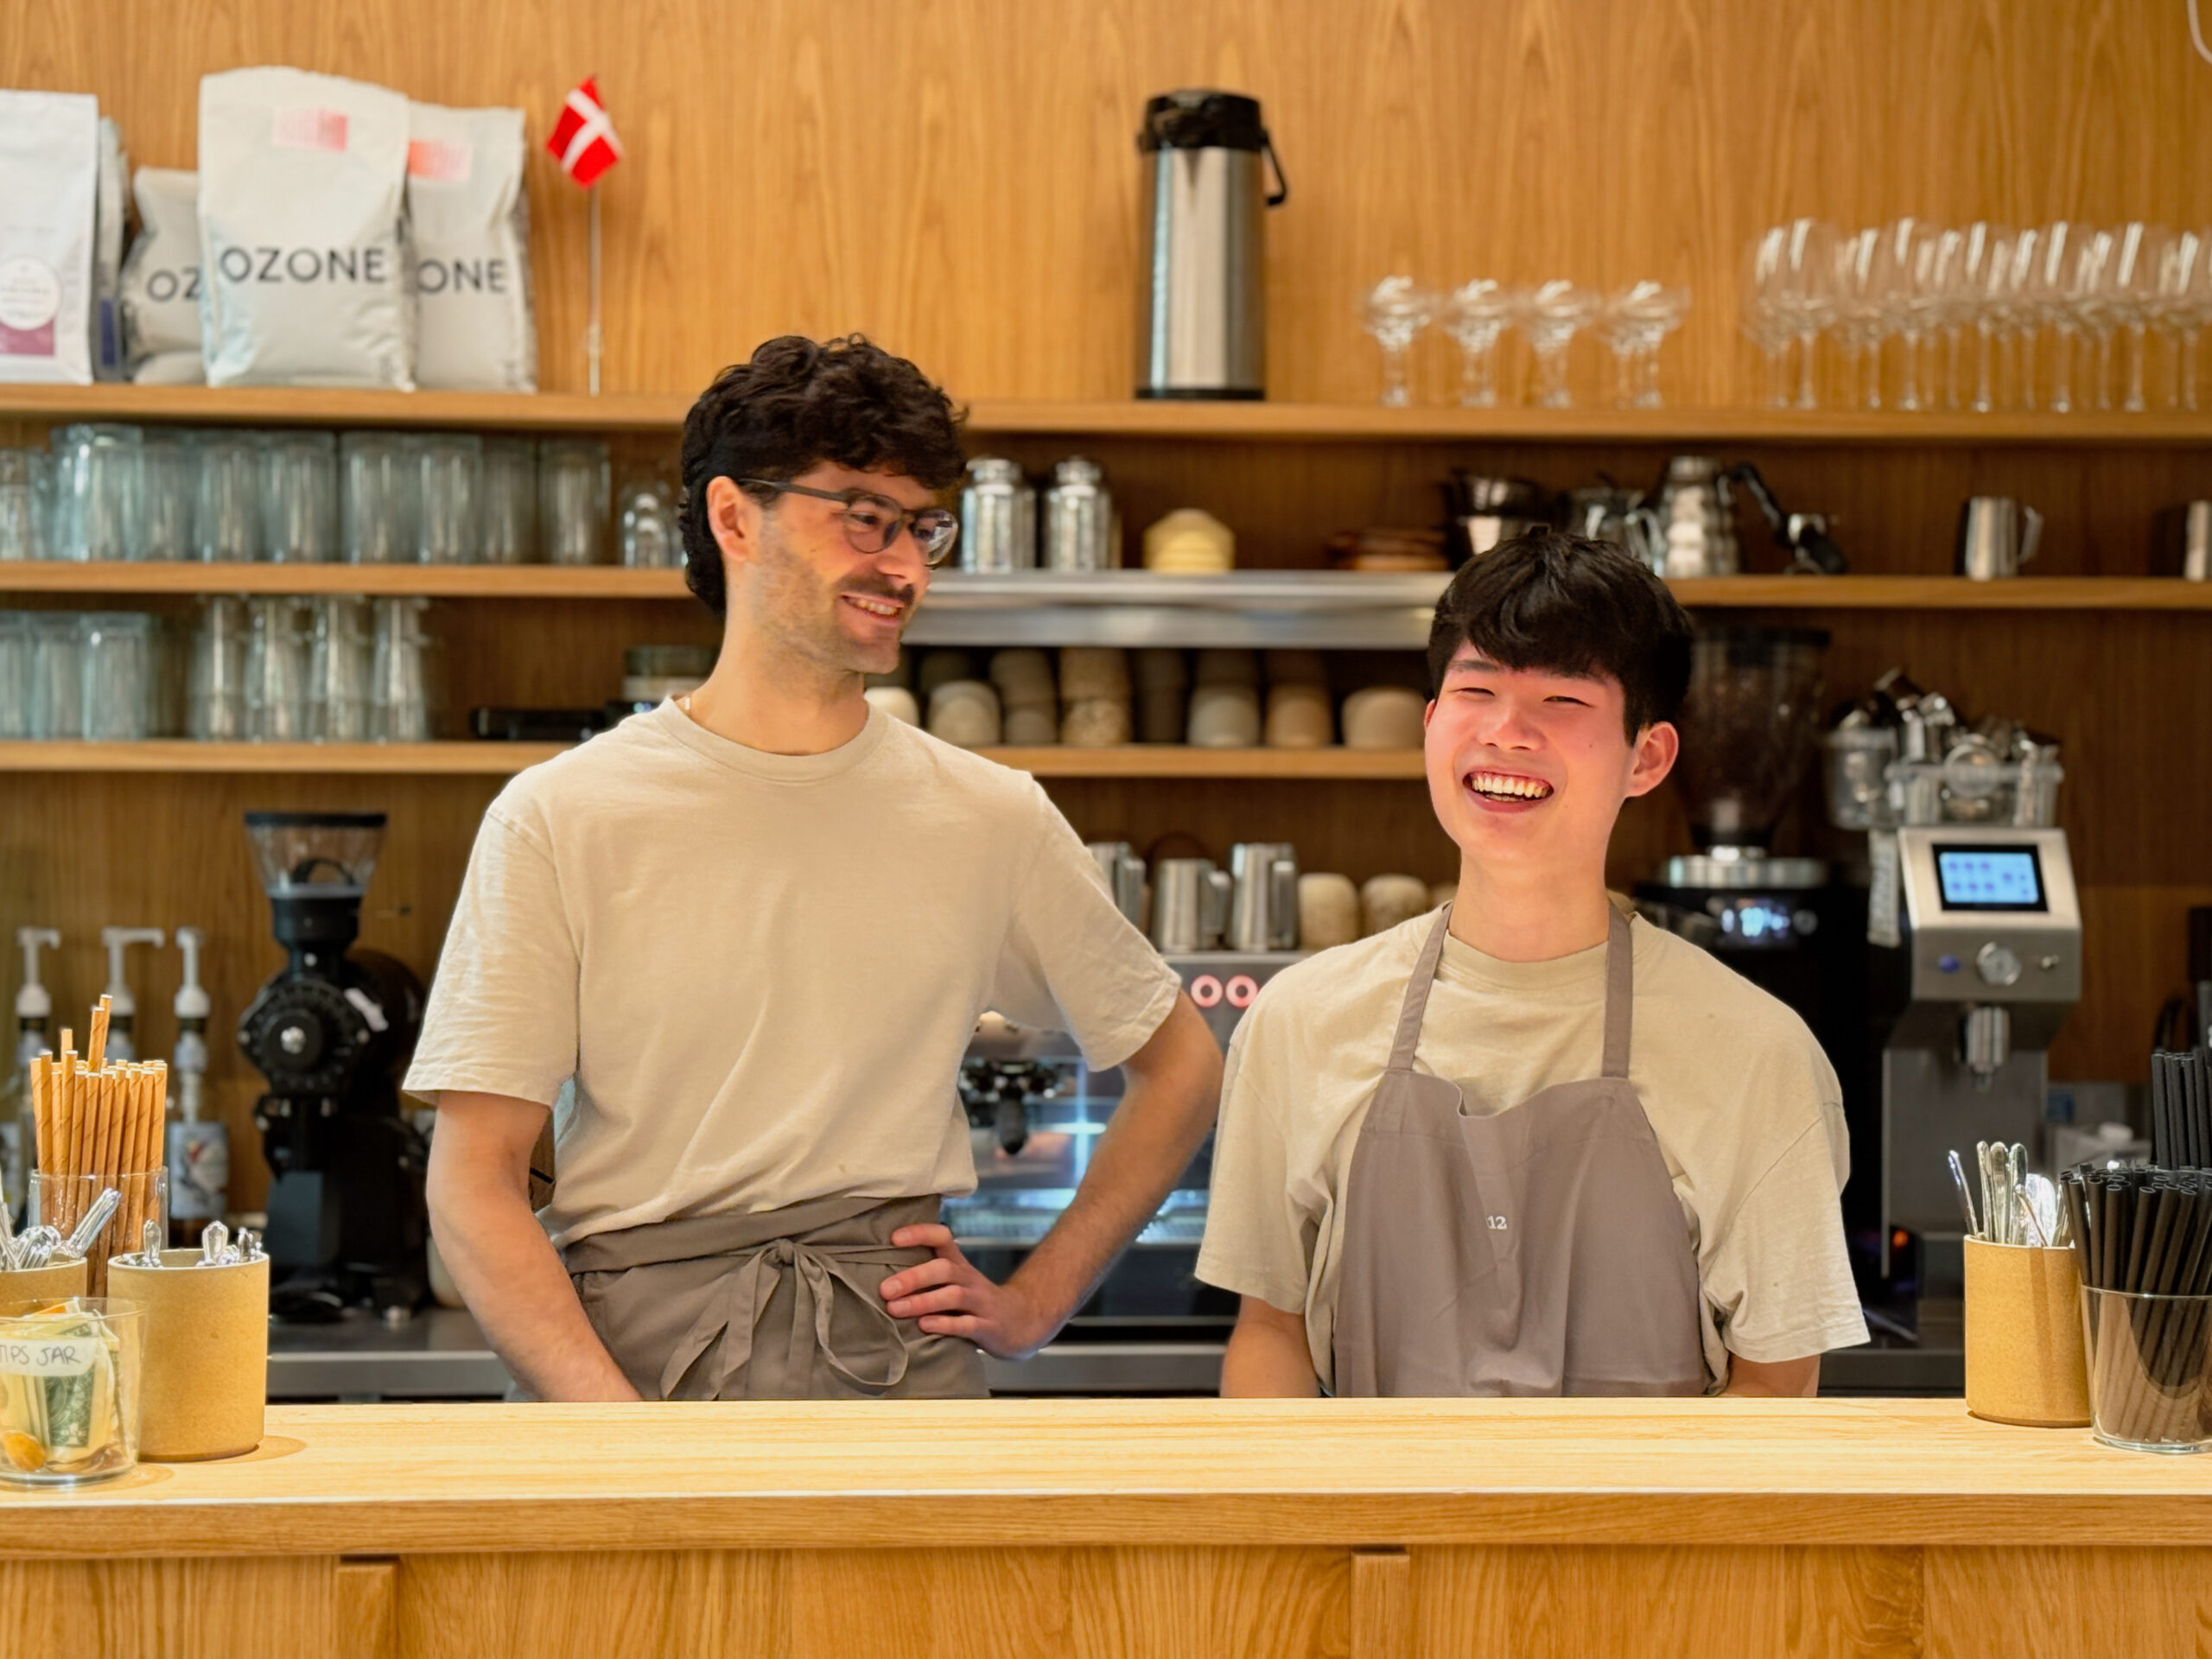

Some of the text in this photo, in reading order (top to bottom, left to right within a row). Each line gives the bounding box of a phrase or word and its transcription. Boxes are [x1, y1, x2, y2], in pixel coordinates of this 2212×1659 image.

[219, 247, 385, 283] OZONE
[416, 259, 507, 293] ONE
[1487, 1216, 1508, 1230] 12
[36, 1345, 82, 1367] JAR
